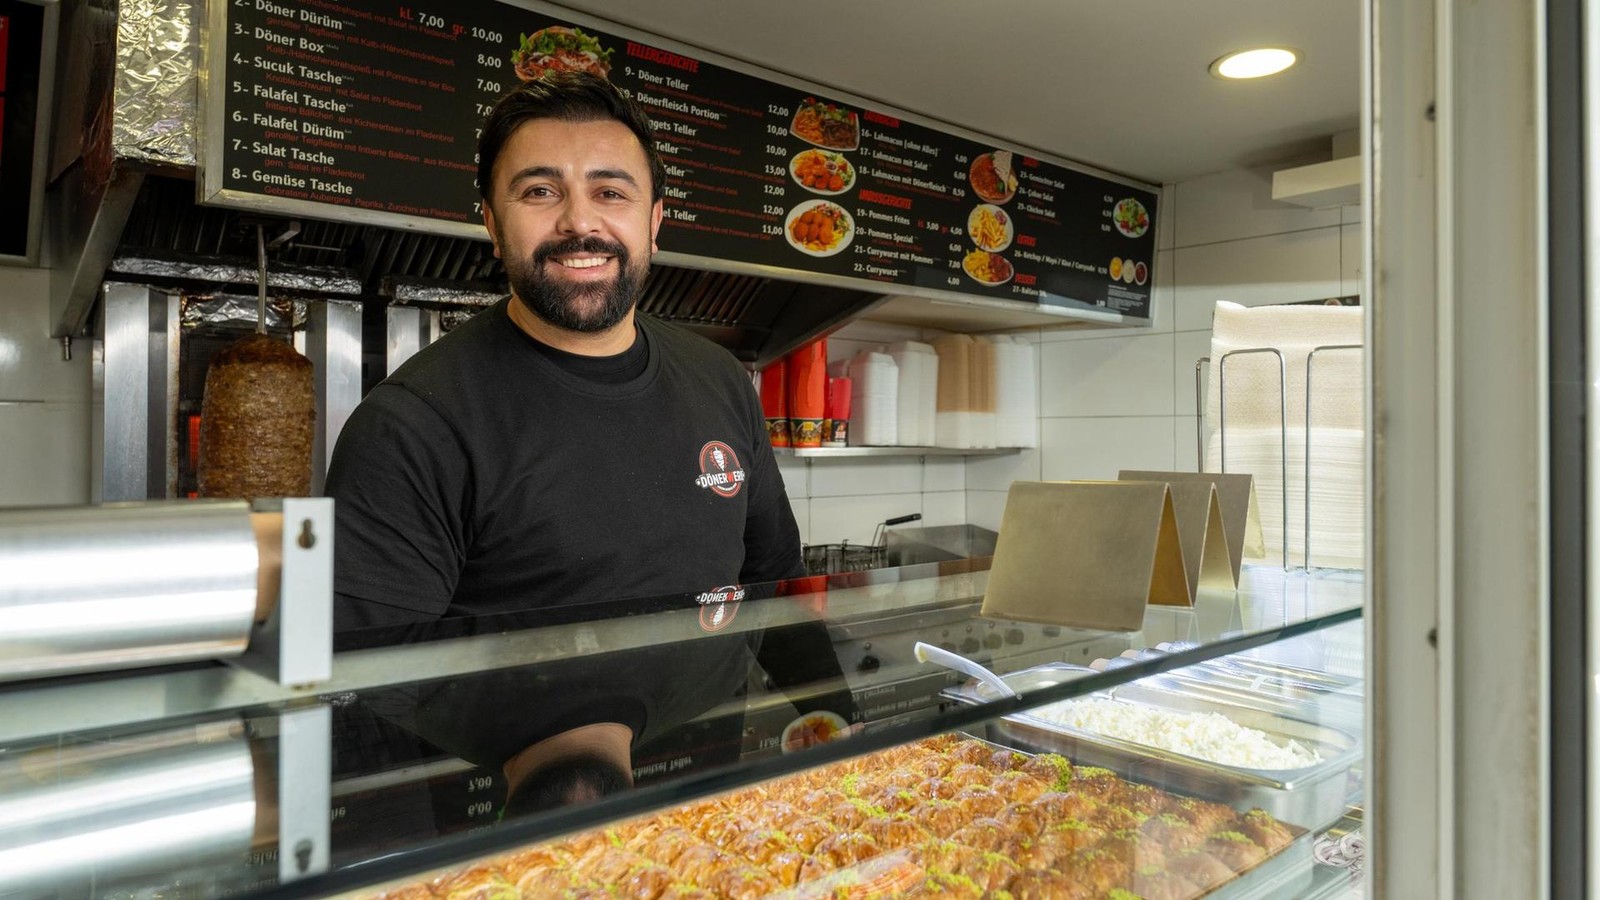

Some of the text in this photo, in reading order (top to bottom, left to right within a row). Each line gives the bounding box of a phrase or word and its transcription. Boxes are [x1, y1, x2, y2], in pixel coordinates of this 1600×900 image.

[255, 0, 296, 18] Döner
[300, 9, 342, 30] Dürüm
[419, 13, 444, 28] 7,00
[452, 24, 467, 36] gr.
[472, 27, 502, 43] 10,00
[234, 23, 250, 35] 3-
[255, 27, 295, 46] Döner
[300, 38, 324, 53] Box
[478, 53, 501, 68] 8,00
[626, 41, 699, 73] TELLERGERICHTE
[233, 53, 342, 84] 4- Sucuk Tasche
[477, 79, 500, 93] 7,00
[625, 67, 690, 92] 9- Döner Teller
[233, 81, 346, 113] 5- Falafel Tasche
[476, 103, 493, 116] 7,0
[637, 92, 688, 113] Dönerfleisch
[690, 105, 720, 121] Portion
[768, 104, 789, 117] 12,00
[232, 110, 344, 140] 6- Falafel Dürüm
[673, 123, 697, 137] Teller
[767, 124, 788, 137] 10,00
[861, 129, 872, 138] 16-
[874, 131, 903, 147] Lahmacun
[232, 139, 335, 165] 7- Salat Tasche
[655, 141, 679, 154] Teller
[766, 145, 787, 157] 10,00
[860, 147, 871, 156] 17-
[872, 150, 902, 164] Lahmacun
[903, 159, 913, 168] mit
[914, 161, 928, 171] Salat
[663, 164, 685, 178] Teller
[765, 164, 786, 177] 13,00
[871, 168, 901, 182] Lahmacun
[902, 176, 912, 185] mit
[232, 168, 353, 195] 8- Gemüse Tasche
[664, 186, 687, 200] Teller
[764, 185, 785, 197] 12,00
[673, 210, 696, 222] Teller
[763, 205, 784, 216] 12,00
[857, 208, 868, 217] 19-
[868, 210, 893, 222] Pommes
[762, 225, 783, 236] 11,00
[856, 227, 867, 235] 20-
[868, 228, 892, 240] Pommes
[855, 245, 866, 254] 21-
[867, 246, 899, 259] Currywurst
[900, 252, 910, 261] mit
[911, 253, 933, 265] Pommes
[854, 263, 898, 276] 22- Currywurst
